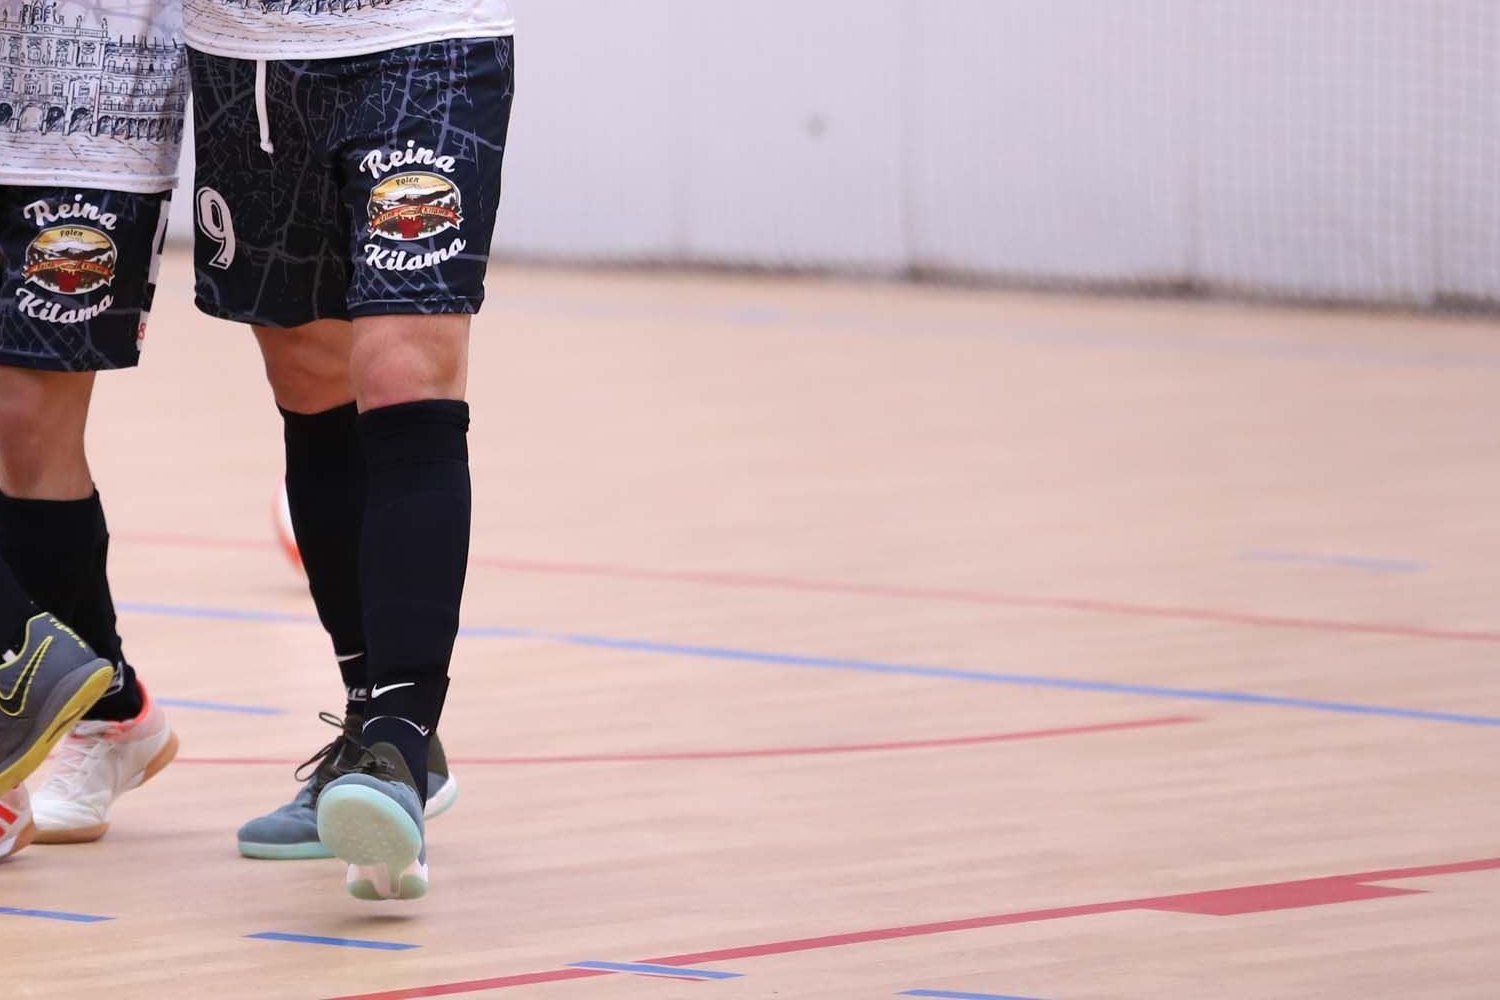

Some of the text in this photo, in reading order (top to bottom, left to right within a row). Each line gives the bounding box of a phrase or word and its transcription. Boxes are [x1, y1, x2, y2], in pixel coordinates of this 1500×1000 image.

[360, 140, 456, 179] Reina
[24, 194, 117, 231] Reina
[196, 186, 236, 270] 9
[364, 237, 467, 271] Kilama
[15, 287, 114, 324] Kilama
